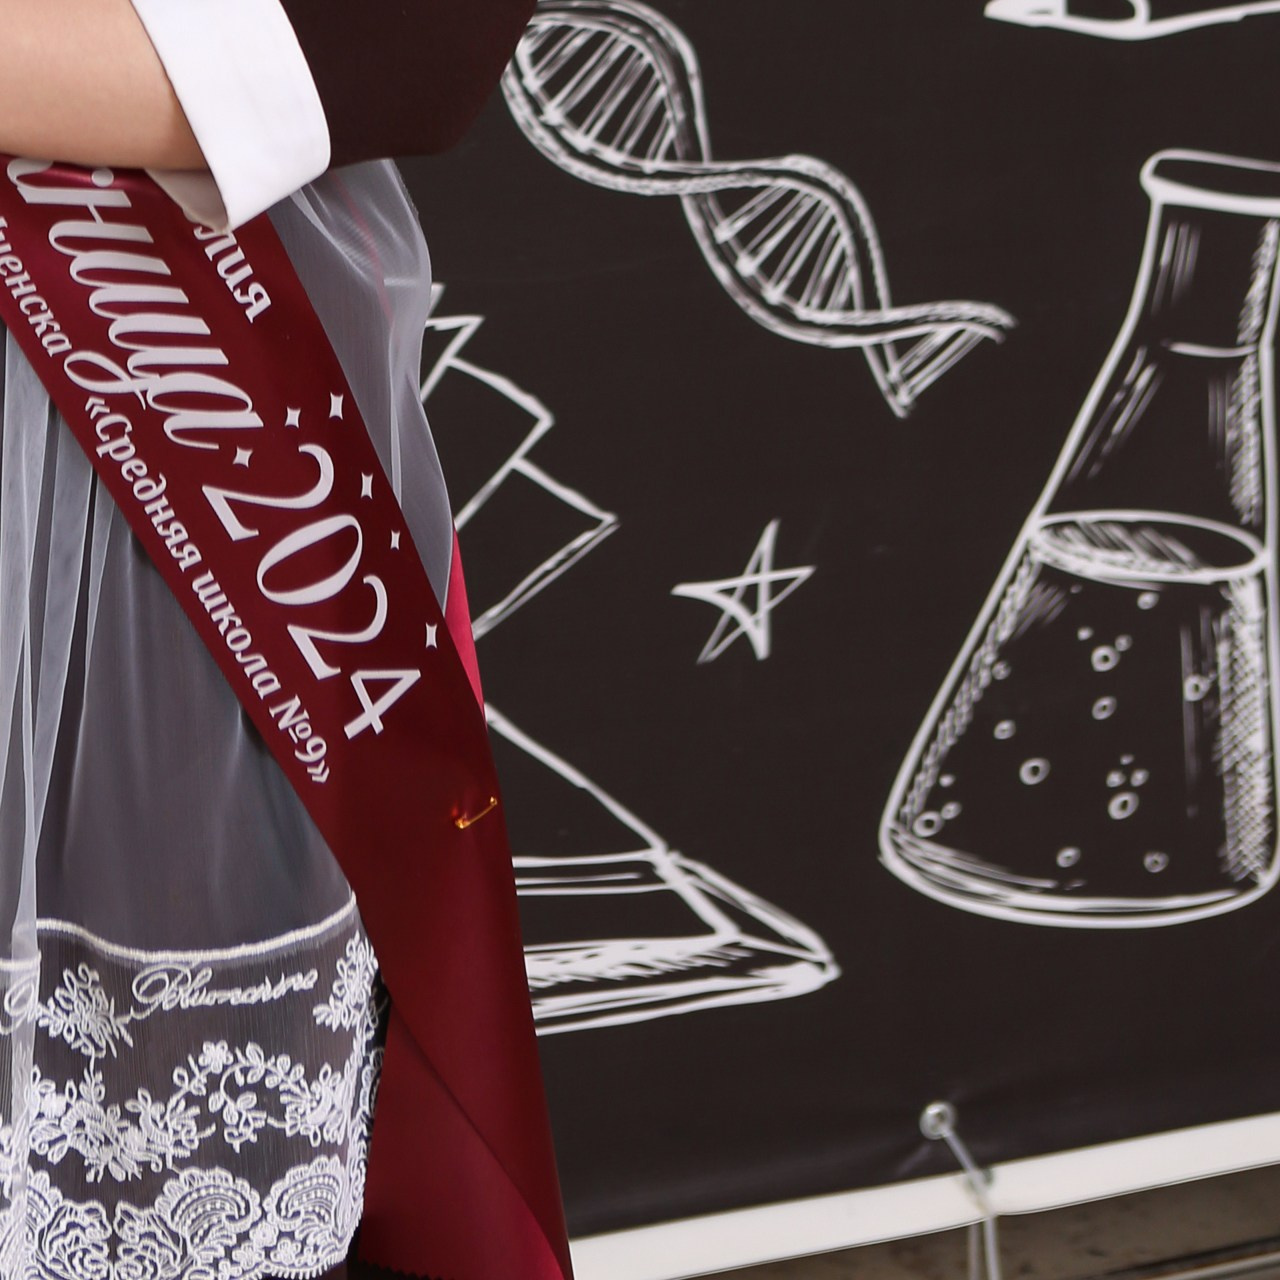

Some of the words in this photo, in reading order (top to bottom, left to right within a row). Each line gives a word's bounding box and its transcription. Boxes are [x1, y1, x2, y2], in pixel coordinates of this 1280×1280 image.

[193, 226, 272, 324] лия
[84, 396, 202, 572] «Средняя
[191, 569, 281, 700] школа
[269, 695, 331, 783] №9»
[201, 443, 421, 739] 2024
